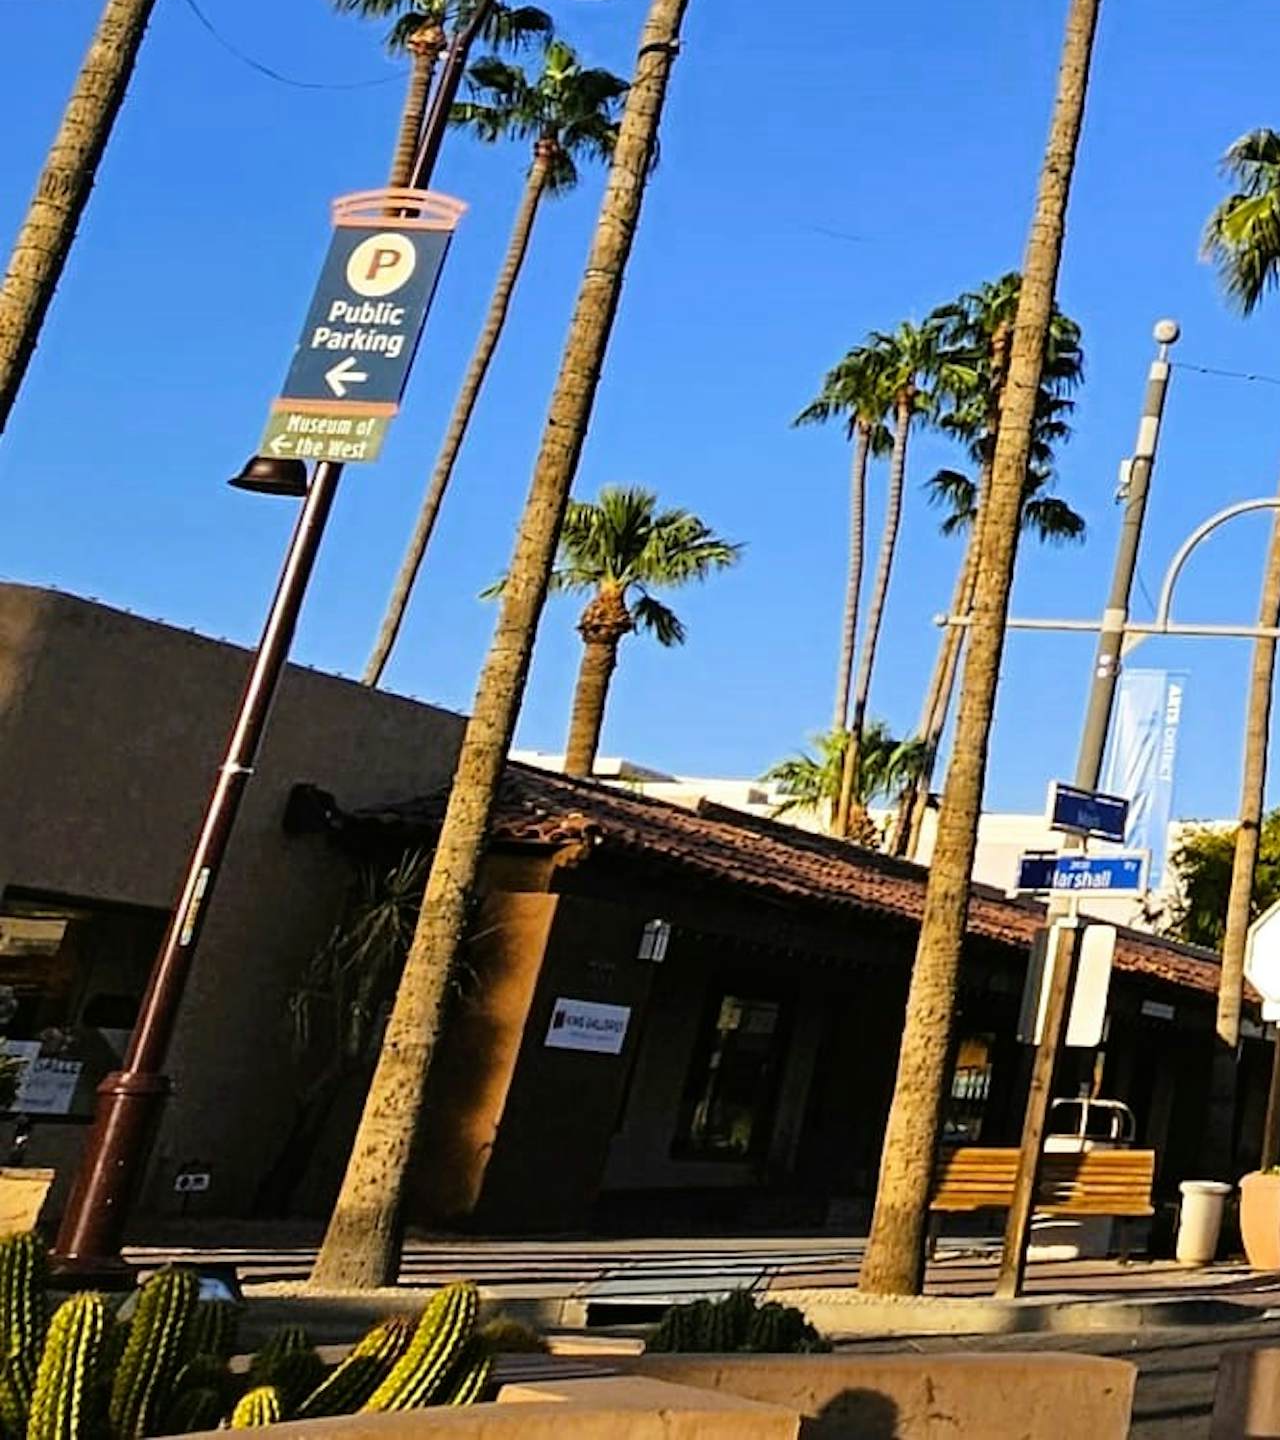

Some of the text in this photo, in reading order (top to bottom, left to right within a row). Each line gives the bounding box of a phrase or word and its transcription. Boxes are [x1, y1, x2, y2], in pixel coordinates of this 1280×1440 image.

[365, 248, 401, 281] P
[328, 301, 404, 326] Public
[311, 328, 404, 358] Parking
[287, 414, 375, 436] Museum of
[295, 438, 366, 459] the West
